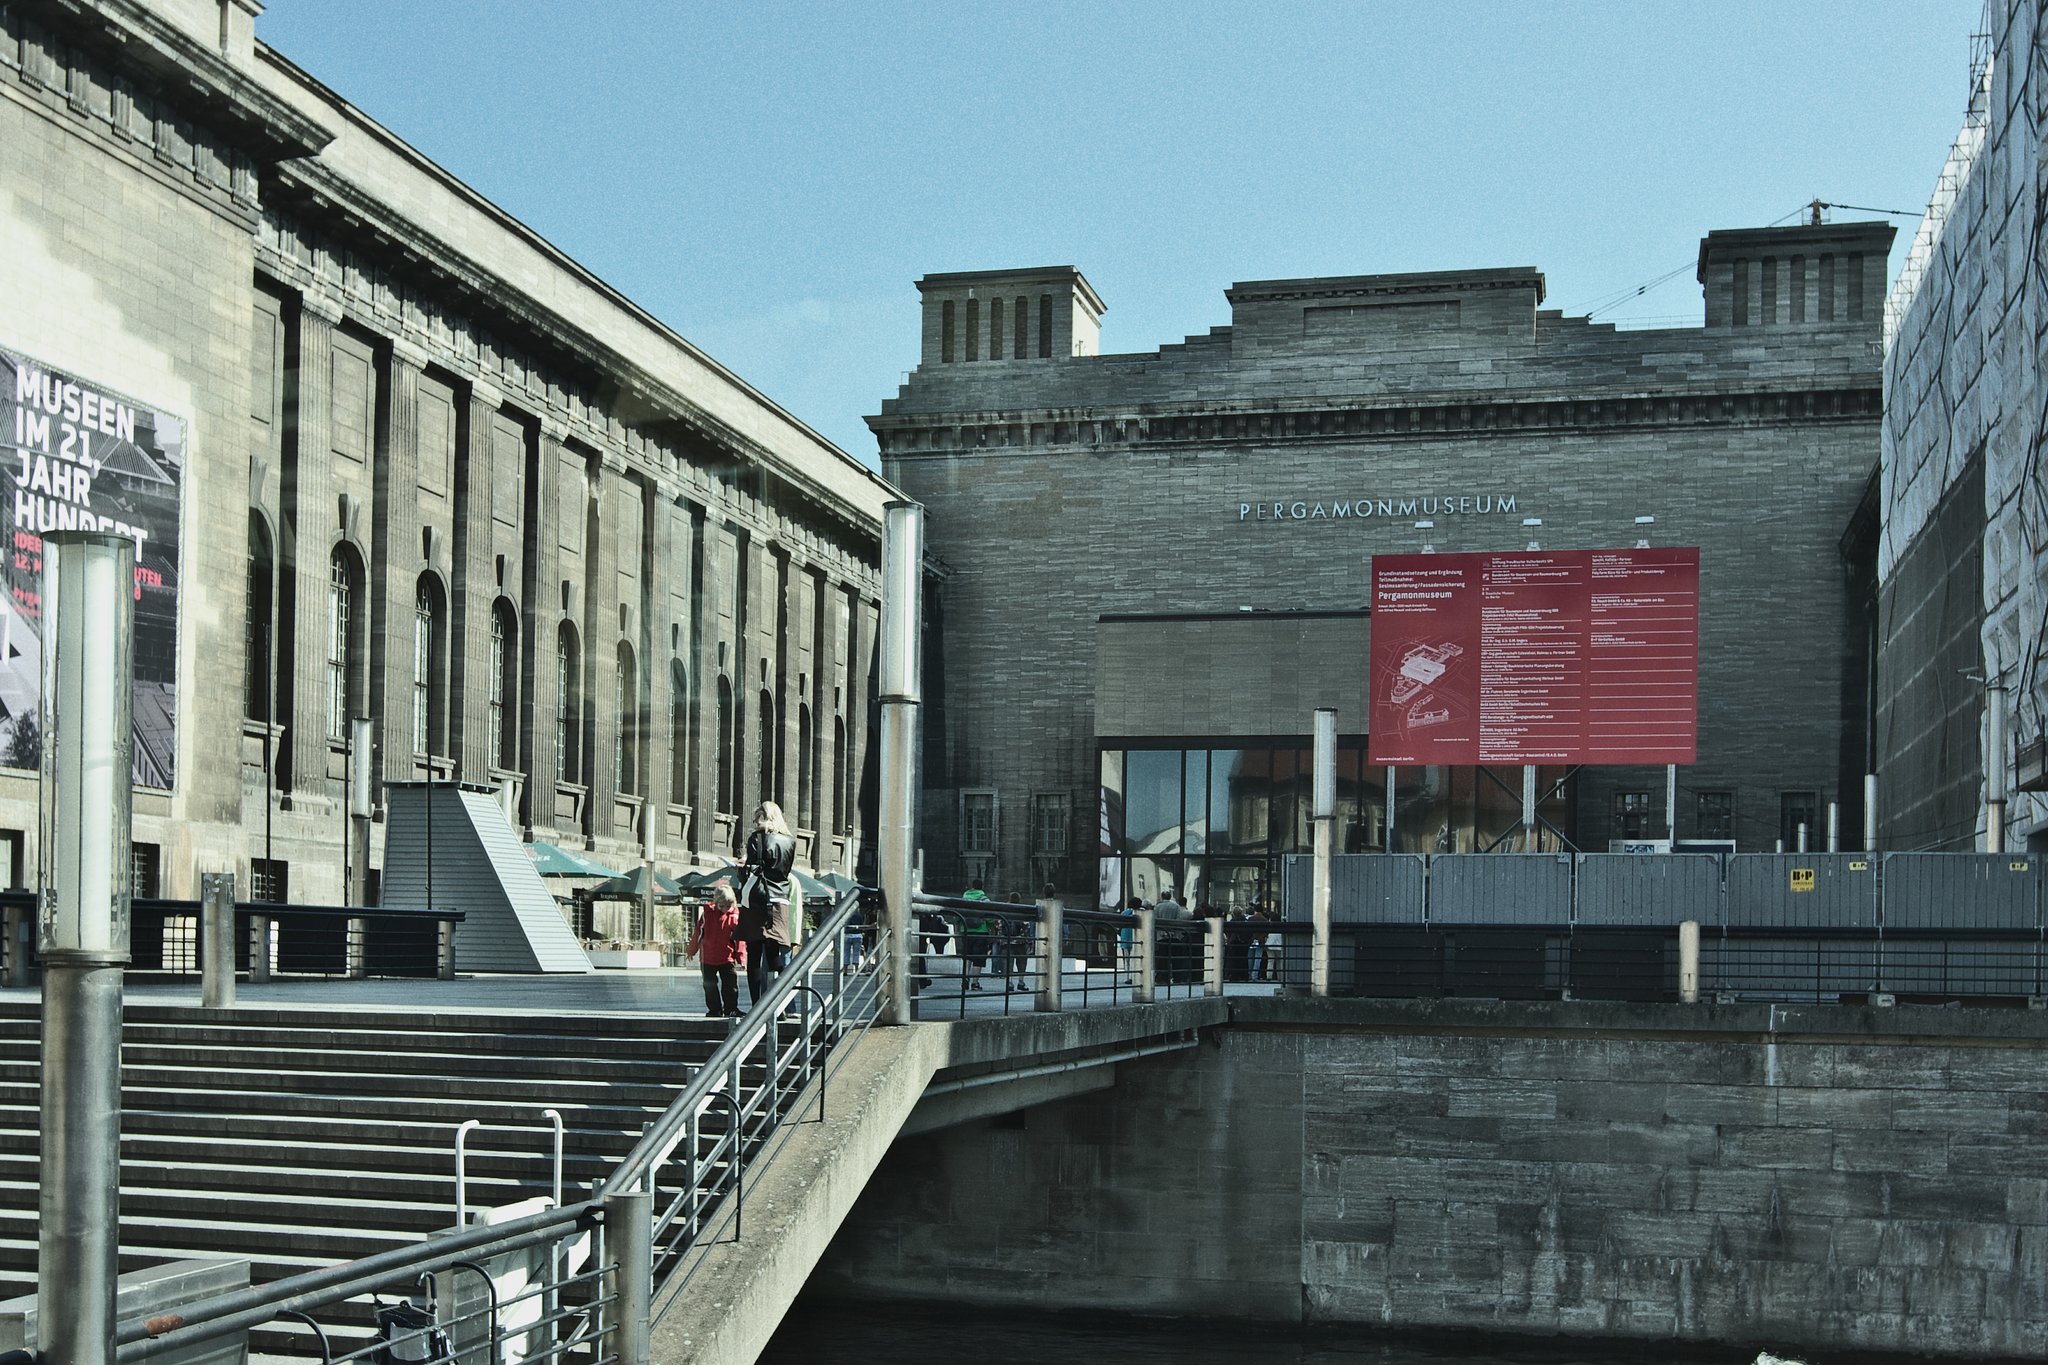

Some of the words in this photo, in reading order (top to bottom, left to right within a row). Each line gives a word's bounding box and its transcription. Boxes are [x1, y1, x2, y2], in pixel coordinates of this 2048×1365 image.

[16, 365, 134, 444] MUSEEN
[16, 406, 50, 452] IM
[60, 422, 100, 471] 21.
[16, 448, 90, 508] JAHR
[1240, 494, 1516, 520] PERGAMONMUSEUM
[1379, 592, 1452, 601] Pergamonmuseum
